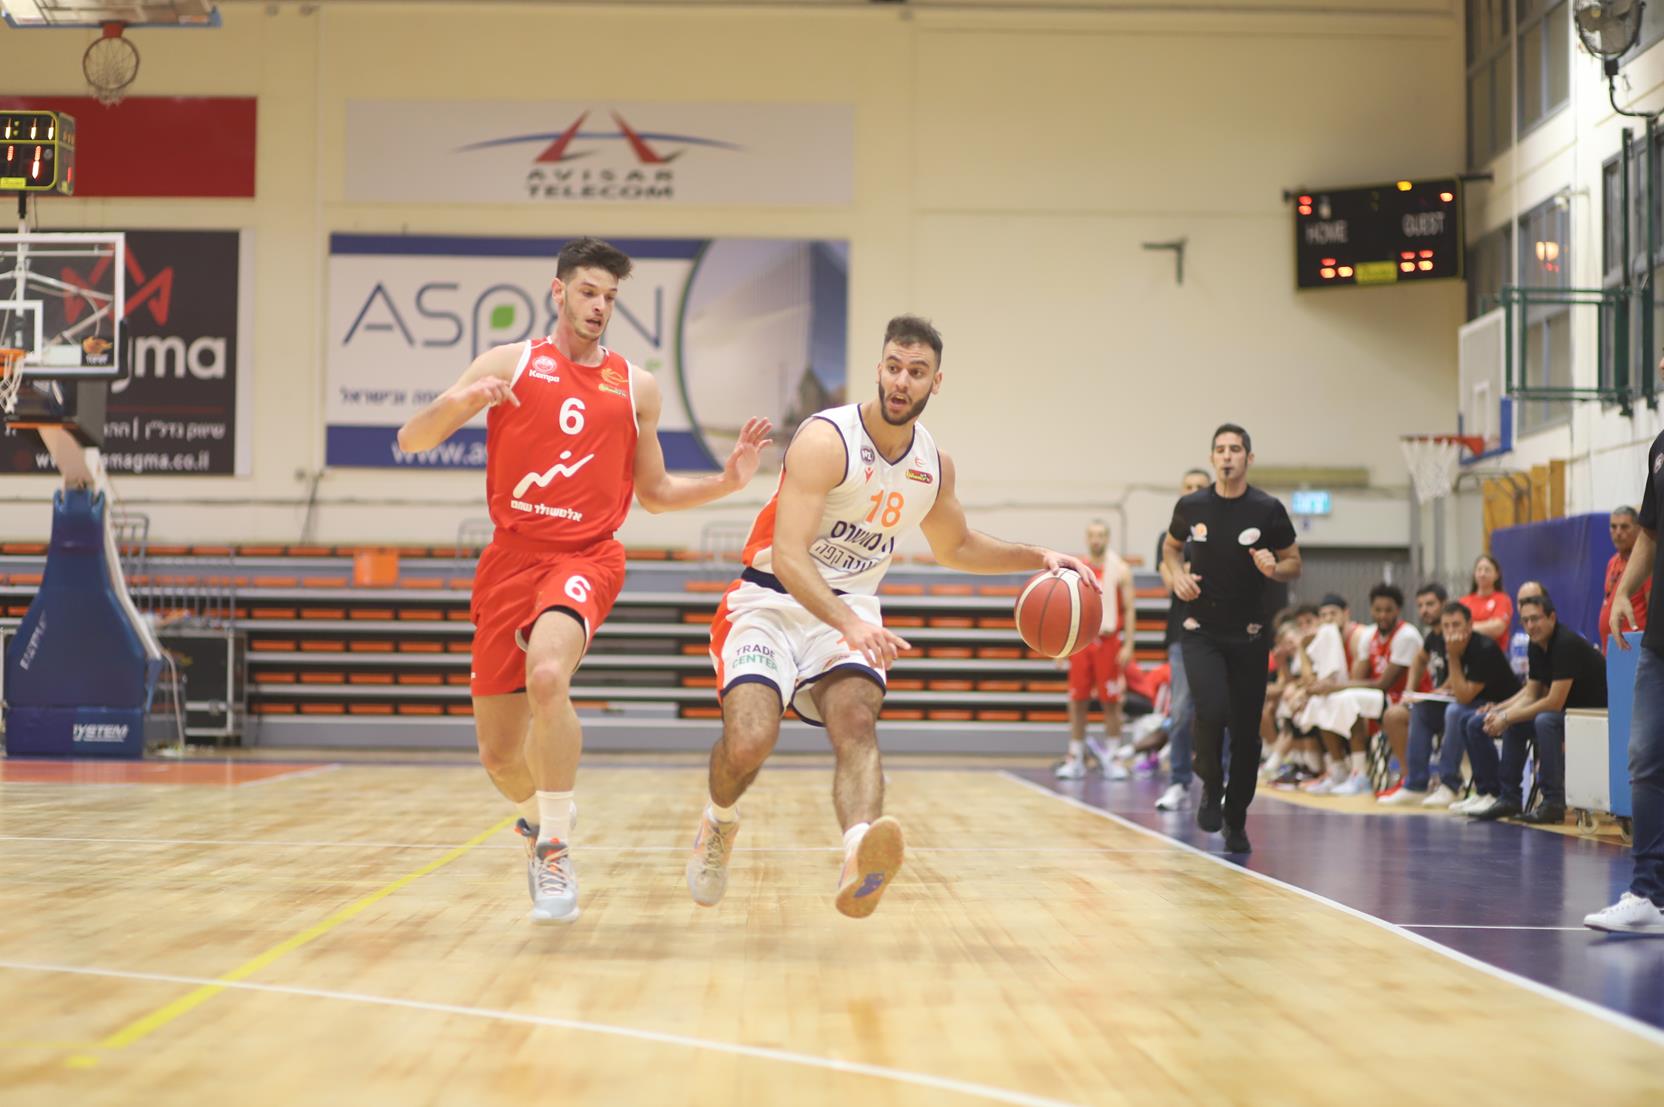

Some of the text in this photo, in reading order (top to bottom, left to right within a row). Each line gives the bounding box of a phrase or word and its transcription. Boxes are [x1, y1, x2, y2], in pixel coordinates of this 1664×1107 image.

[527, 169, 674, 182] AVISAR
[528, 184, 674, 198] TELECOM
[528, 369, 560, 384] Kempa
[558, 397, 586, 436] 6
[865, 489, 905, 528] 18
[564, 575, 592, 604] 6
[736, 644, 776, 658] TRADE
[732, 654, 778, 671] CENTER
